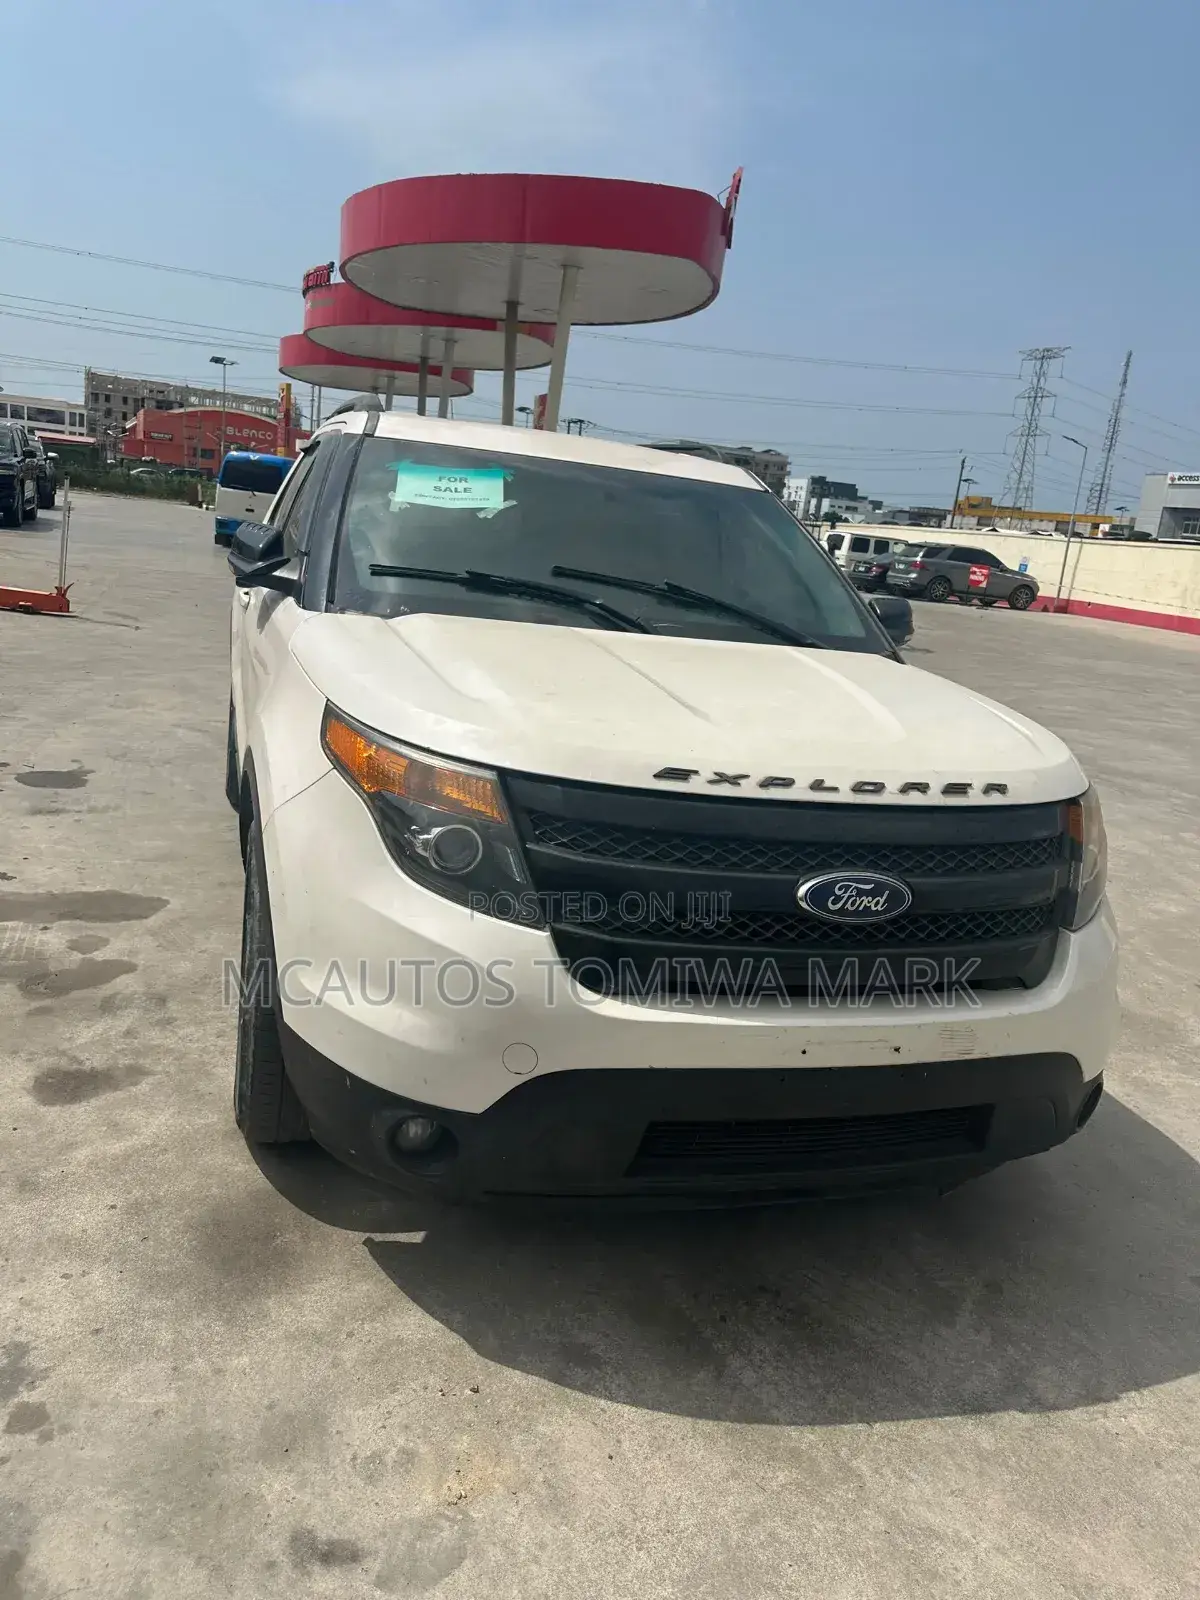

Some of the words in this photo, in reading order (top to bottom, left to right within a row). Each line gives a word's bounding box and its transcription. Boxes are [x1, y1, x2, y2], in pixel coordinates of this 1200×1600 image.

[433, 485, 472, 494] SALE
[437, 476, 468, 484] FOR
[652, 766, 1010, 797] EXPLORER
[827, 881, 890, 912] Ford
